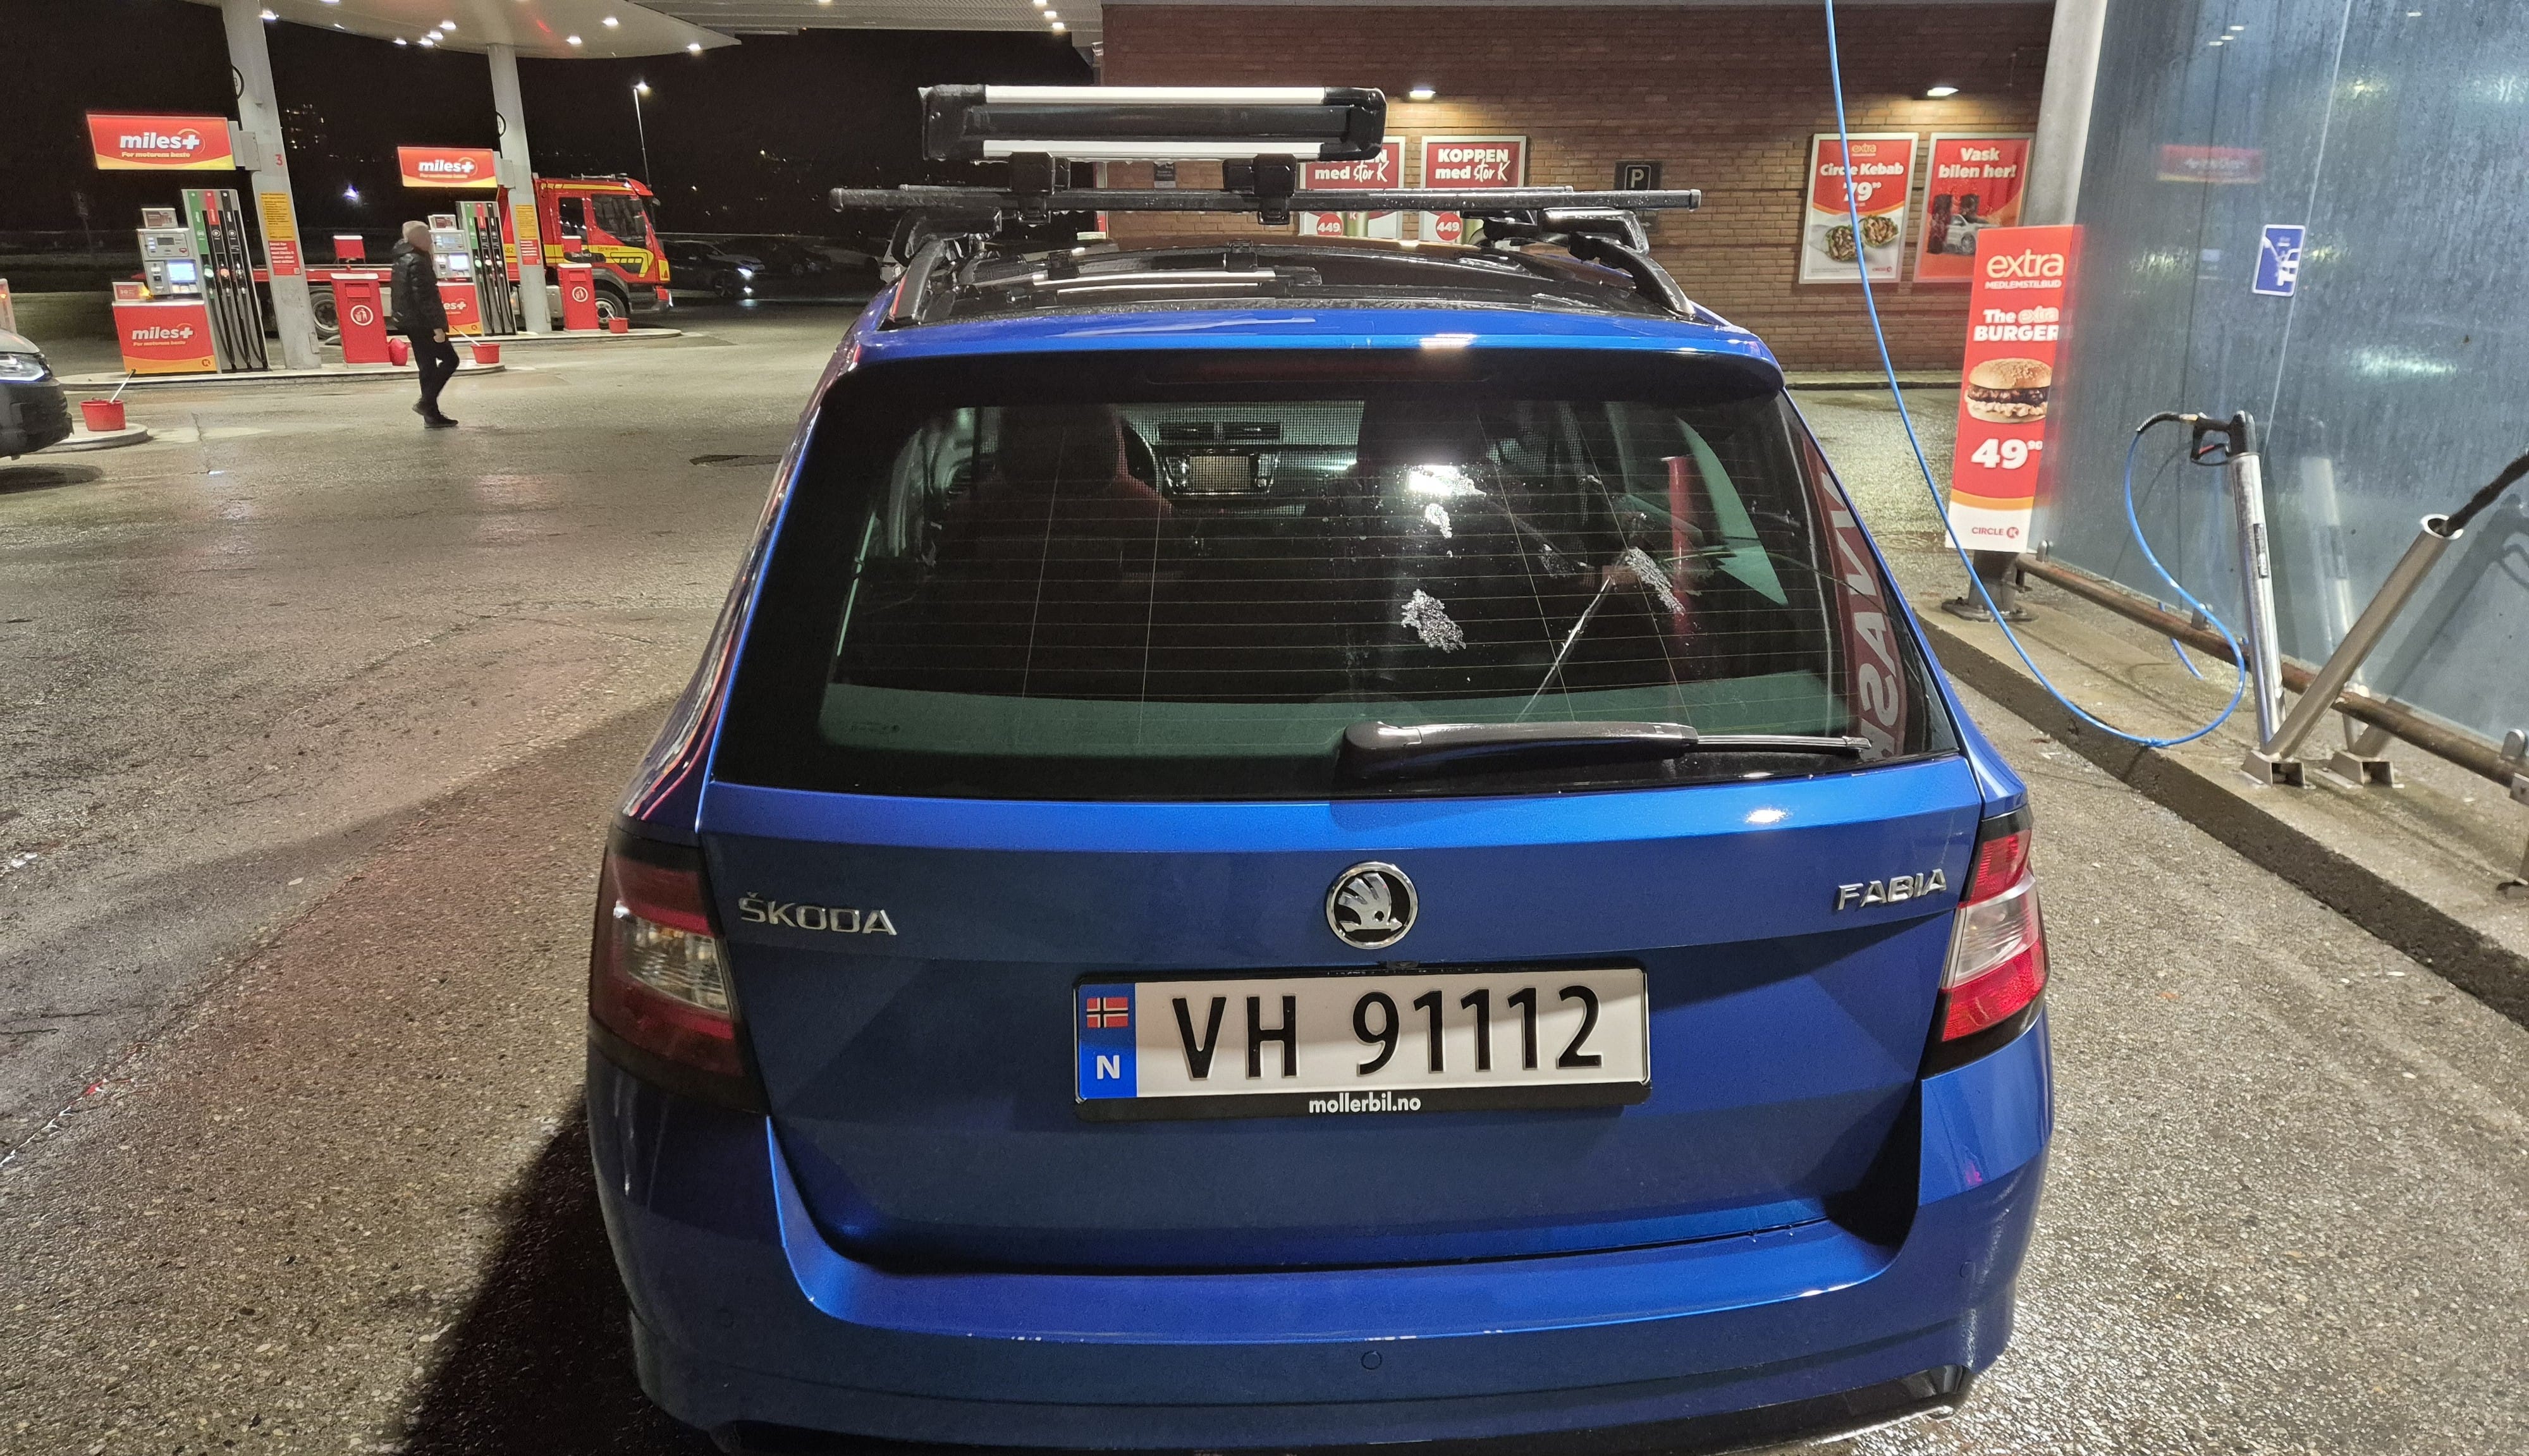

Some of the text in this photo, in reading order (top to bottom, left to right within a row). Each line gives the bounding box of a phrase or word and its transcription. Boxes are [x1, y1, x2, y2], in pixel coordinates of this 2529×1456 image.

[119, 132, 200, 149] miles+
[1852, 143, 1877, 153] extra
[275, 154, 283, 166] 3
[1438, 149, 1509, 162] KOPPEN
[1961, 147, 2000, 161] Vask
[419, 159, 475, 173] miles+
[1315, 160, 1390, 183] med stor K
[1435, 158, 1510, 182] med stor K
[1821, 162, 1904, 176] Circe Kebab
[1938, 164, 2017, 178] bilen her!
[1631, 169, 1644, 188] P
[1986, 248, 2064, 278] extra
[1985, 279, 2062, 289] MEDLEMSTILBUD
[1983, 305, 2059, 324] The extra
[132, 326, 193, 340] miles+
[1971, 438, 2028, 469] 49
[1971, 527, 2004, 535] CIRCLE
[1837, 868, 1947, 910] FABIA
[738, 891, 897, 936] ŠKODA
[1171, 985, 1603, 1079] VH 91112
[1096, 1055, 1120, 1080] N
[1308, 1091, 1421, 1113] mollerbil.no
